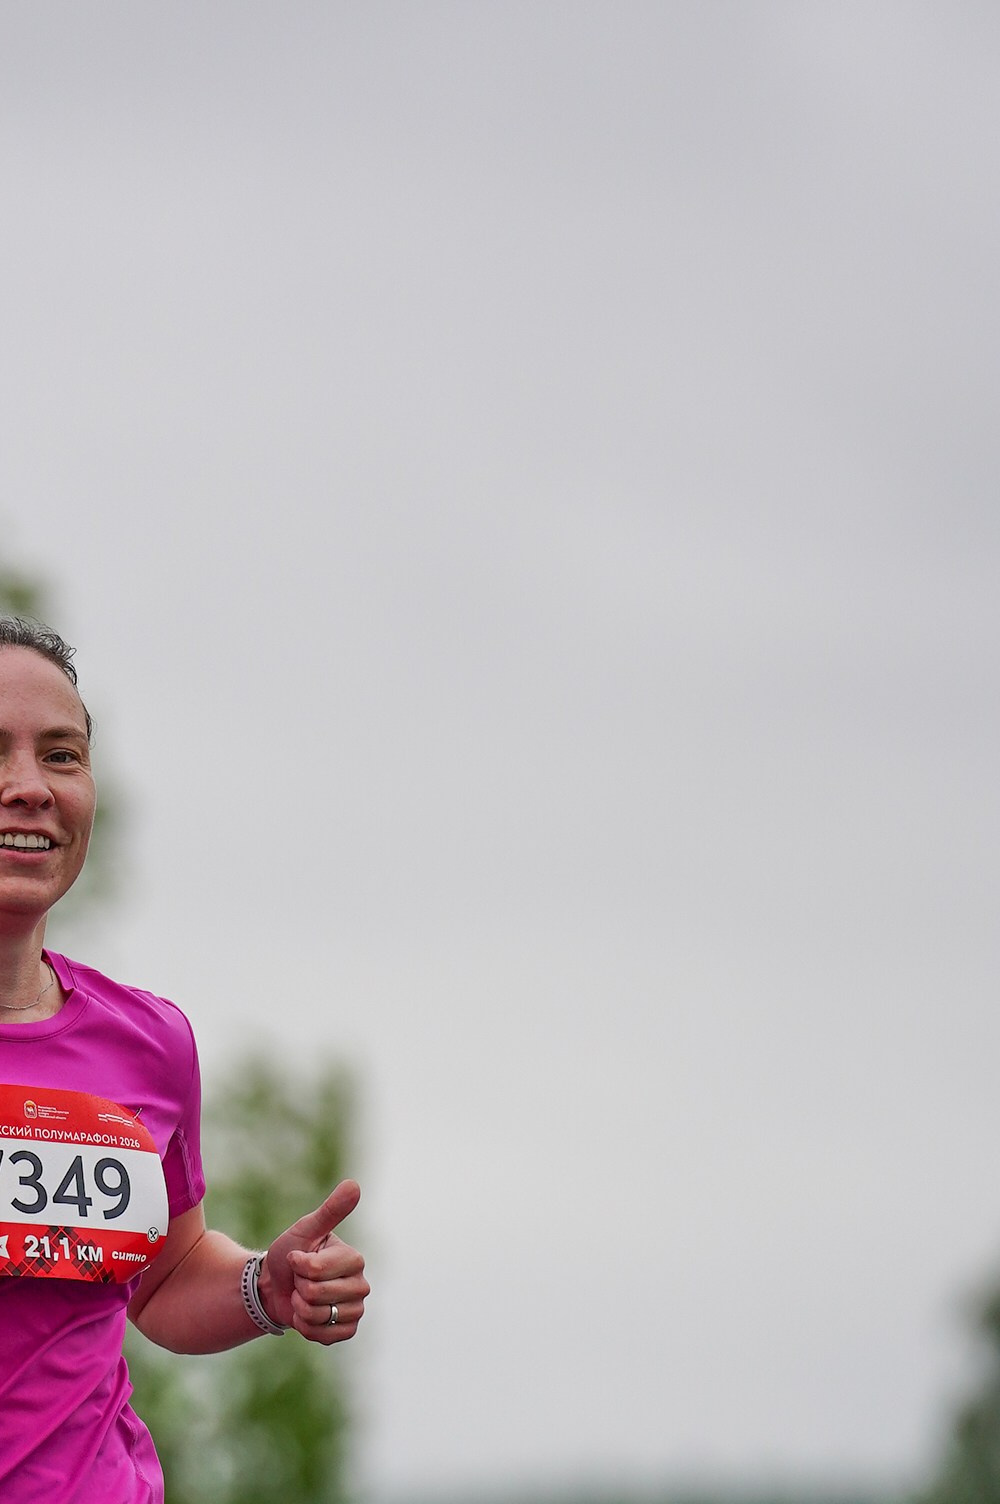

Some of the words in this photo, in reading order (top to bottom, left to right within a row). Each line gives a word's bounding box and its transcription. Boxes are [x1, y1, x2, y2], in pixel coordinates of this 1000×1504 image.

[35, 1128, 118, 1145] ПОЛУМАРАФОН
[119, 1137, 140, 1148] 2026
[24, 1235, 70, 1261] 21,1
